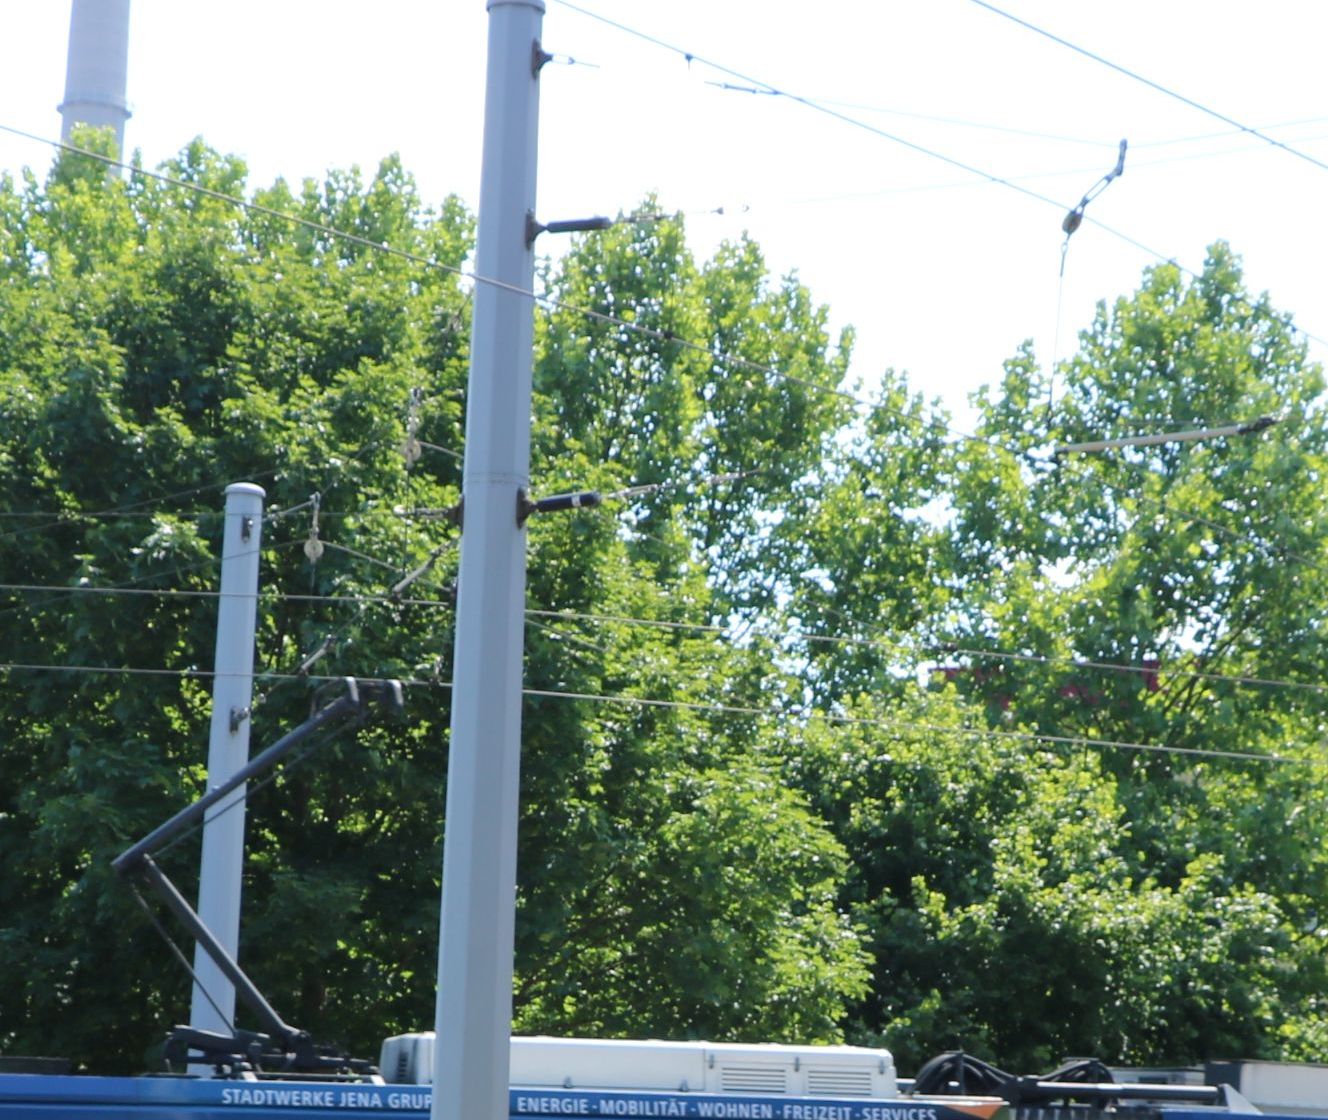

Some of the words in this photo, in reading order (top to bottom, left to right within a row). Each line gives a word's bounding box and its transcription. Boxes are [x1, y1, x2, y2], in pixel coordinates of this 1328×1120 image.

[222, 1088, 333, 1106] STADTWERKE
[339, 1092, 383, 1108] JENA
[387, 1093, 433, 1110] GRUP
[517, 1097, 589, 1114] ENERGIE
[599, 1098, 689, 1117] MOBILITÄT
[698, 1102, 772, 1119] WOHNEN
